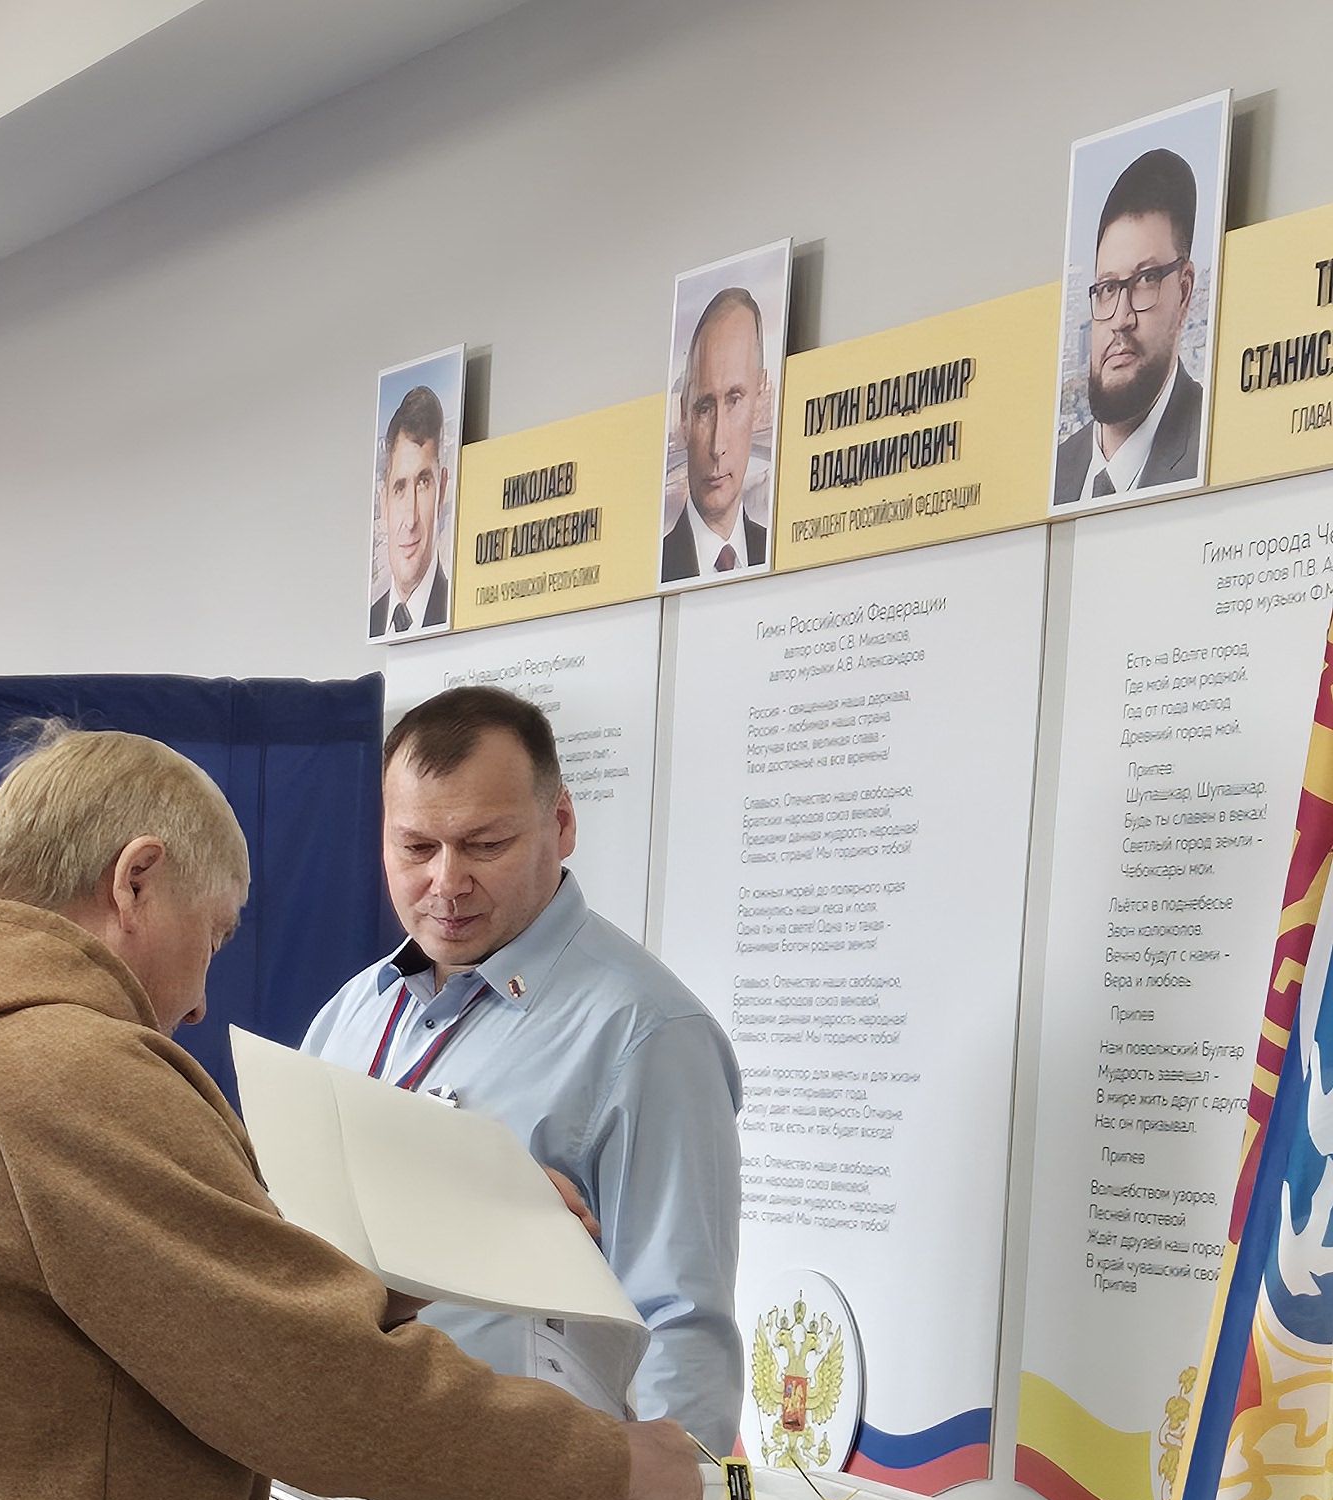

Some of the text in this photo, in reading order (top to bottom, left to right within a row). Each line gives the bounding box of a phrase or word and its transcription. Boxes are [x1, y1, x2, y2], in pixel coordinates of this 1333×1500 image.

[1240, 329, 1333, 394] СТАНИС
[804, 358, 976, 437] ПУТИН ВЛАДИМИР
[1291, 401, 1333, 434] ГЛАВА
[502, 461, 576, 510] НИКОЛАЕВ
[810, 421, 961, 492] ВЛАДИМИРОВИЧ
[475, 507, 602, 565] ОЛЕГ АЛЕКСЕЕВИЧ
[792, 483, 981, 543] ПРЕЗИДЕНТ РОССИЙСКОЙ ФЕДЕРАЦИИ
[475, 583, 499, 605] ГЛАВА
[1211, 1097, 1248, 1114] друго
